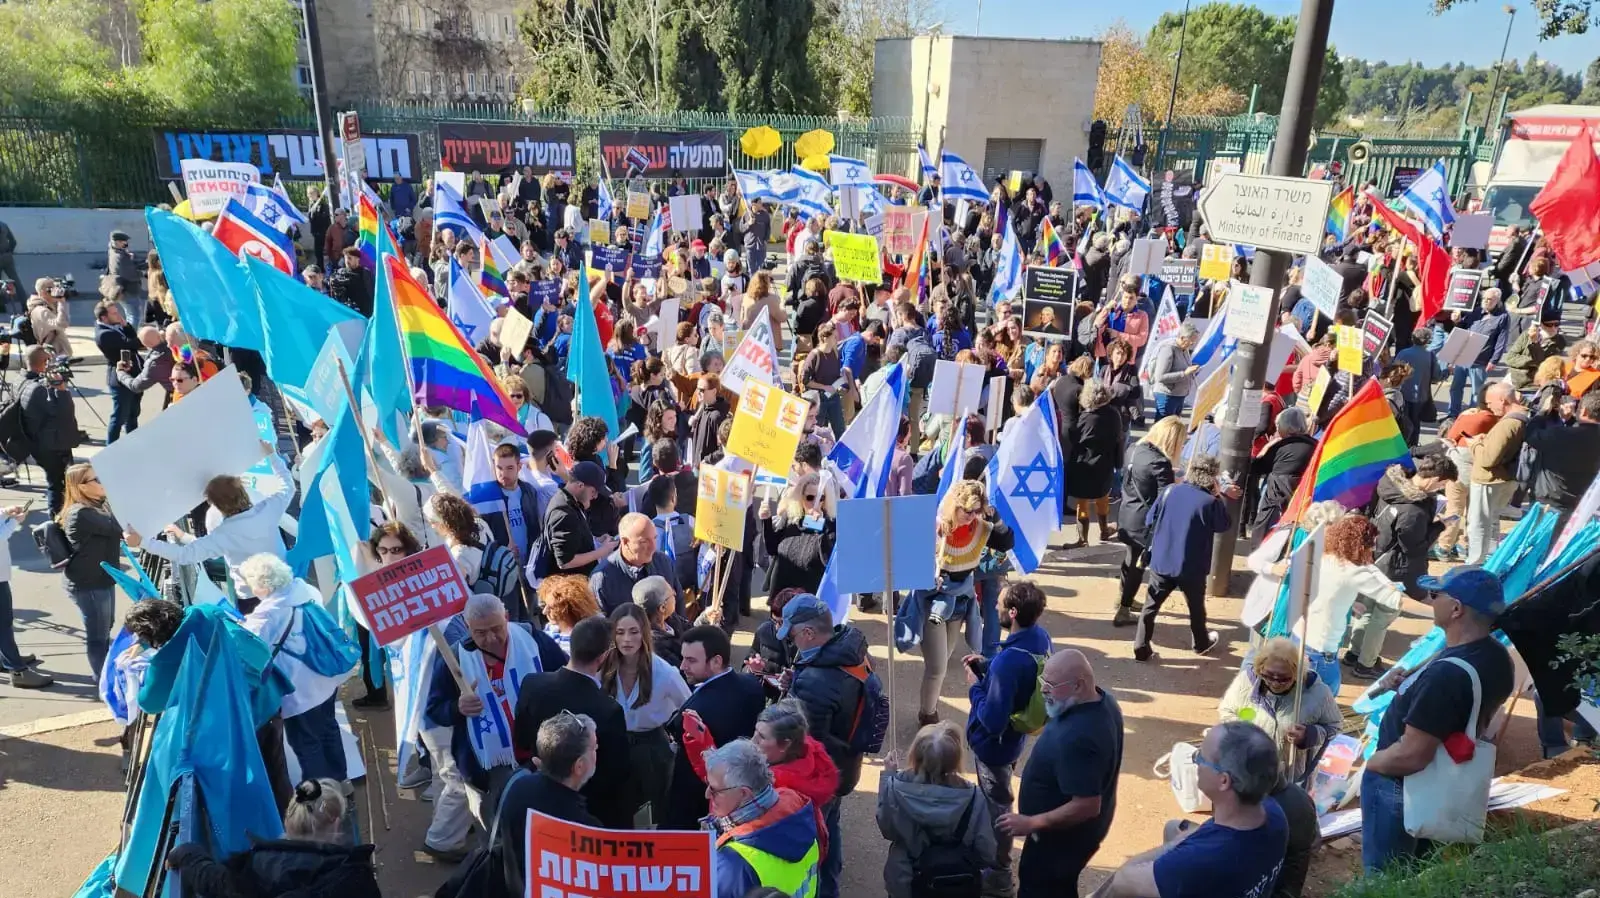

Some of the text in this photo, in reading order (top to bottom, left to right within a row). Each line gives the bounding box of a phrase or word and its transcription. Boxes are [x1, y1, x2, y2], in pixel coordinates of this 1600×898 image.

[268, 133, 412, 179] חושי
[443, 137, 573, 167] ממשלה עבריינית
[669, 140, 723, 169] ממשלה
[1233, 183, 1312, 205] משרד האוצר
[1232, 203, 1304, 227] وزارة المالية
[1218, 220, 1312, 244] Ministry of Finance
[365, 562, 454, 611] השחיתות
[373, 580, 463, 632] מדבקת
[570, 830, 656, 858] זהירות!
[538, 849, 701, 892] השחיתות
